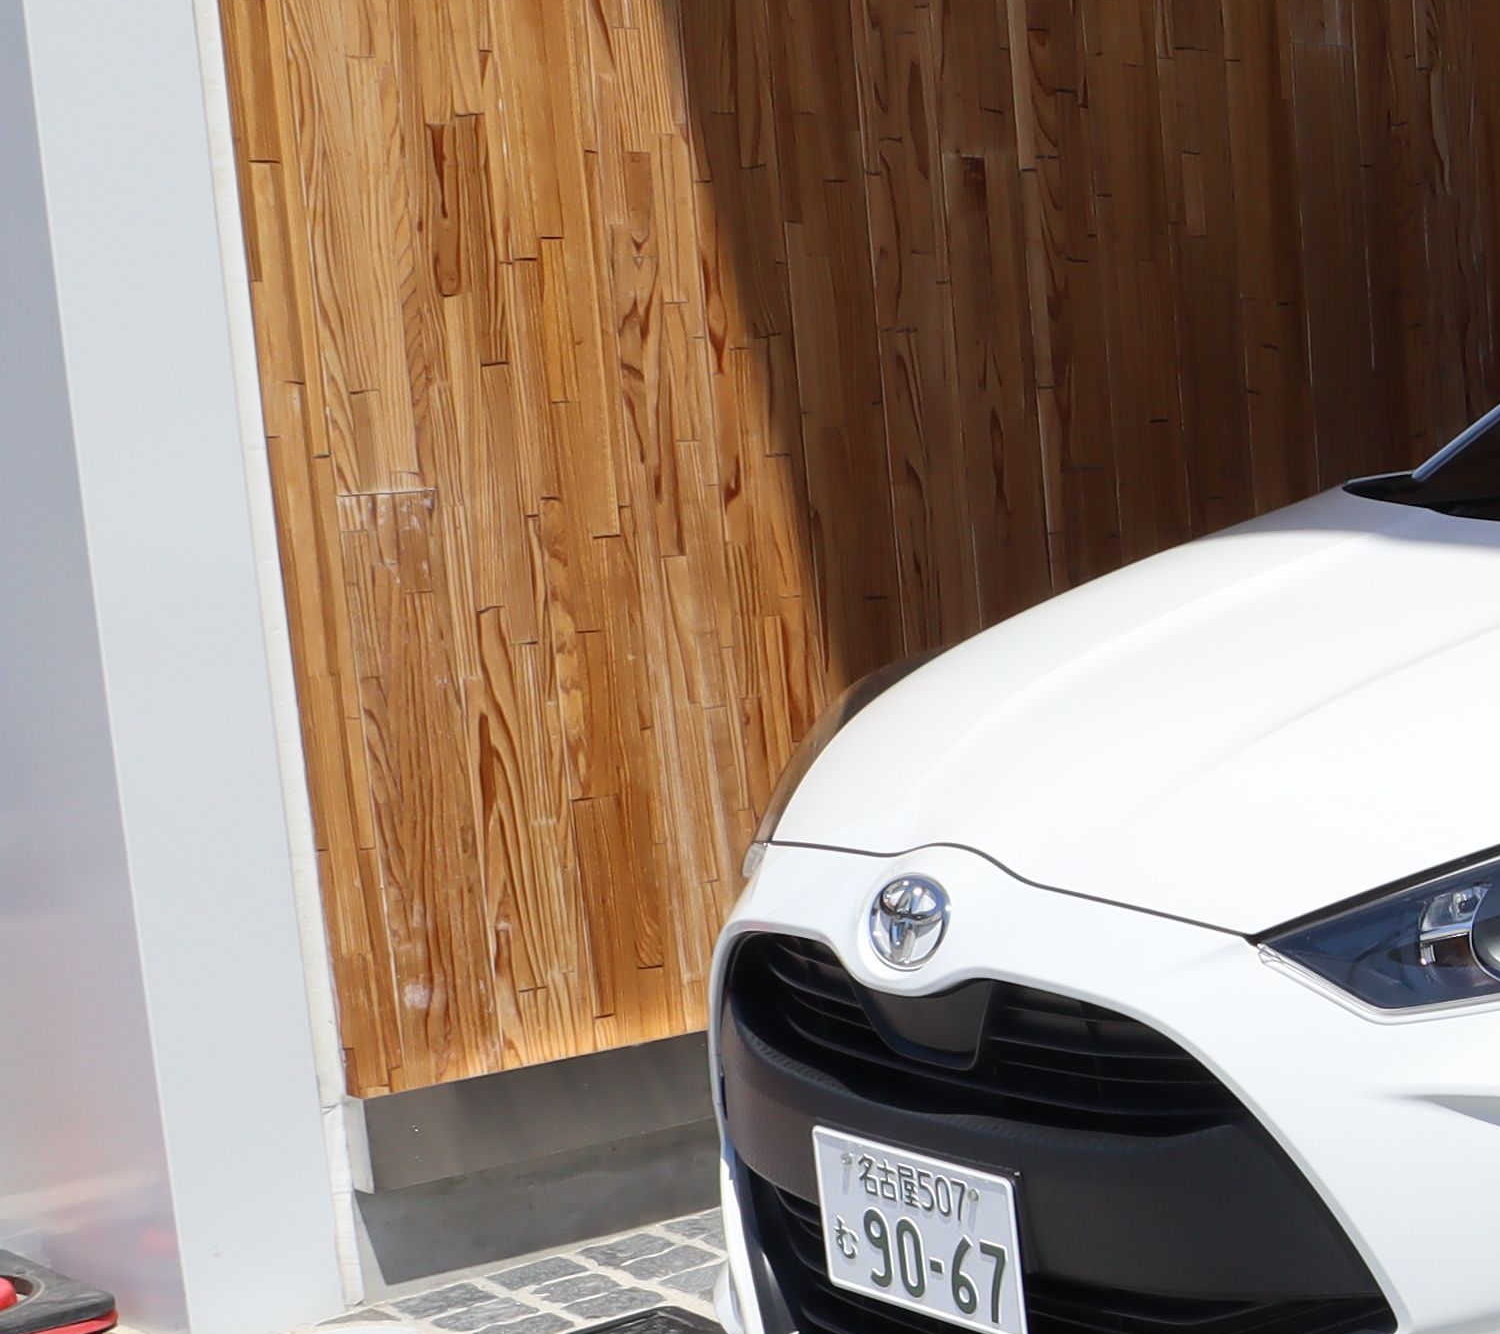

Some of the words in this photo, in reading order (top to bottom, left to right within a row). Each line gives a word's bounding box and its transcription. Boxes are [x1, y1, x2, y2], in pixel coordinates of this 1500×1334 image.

[858, 1153, 967, 1222] 名古屋507
[834, 1215, 859, 1260] む
[863, 1207, 1008, 1325] 90-67
